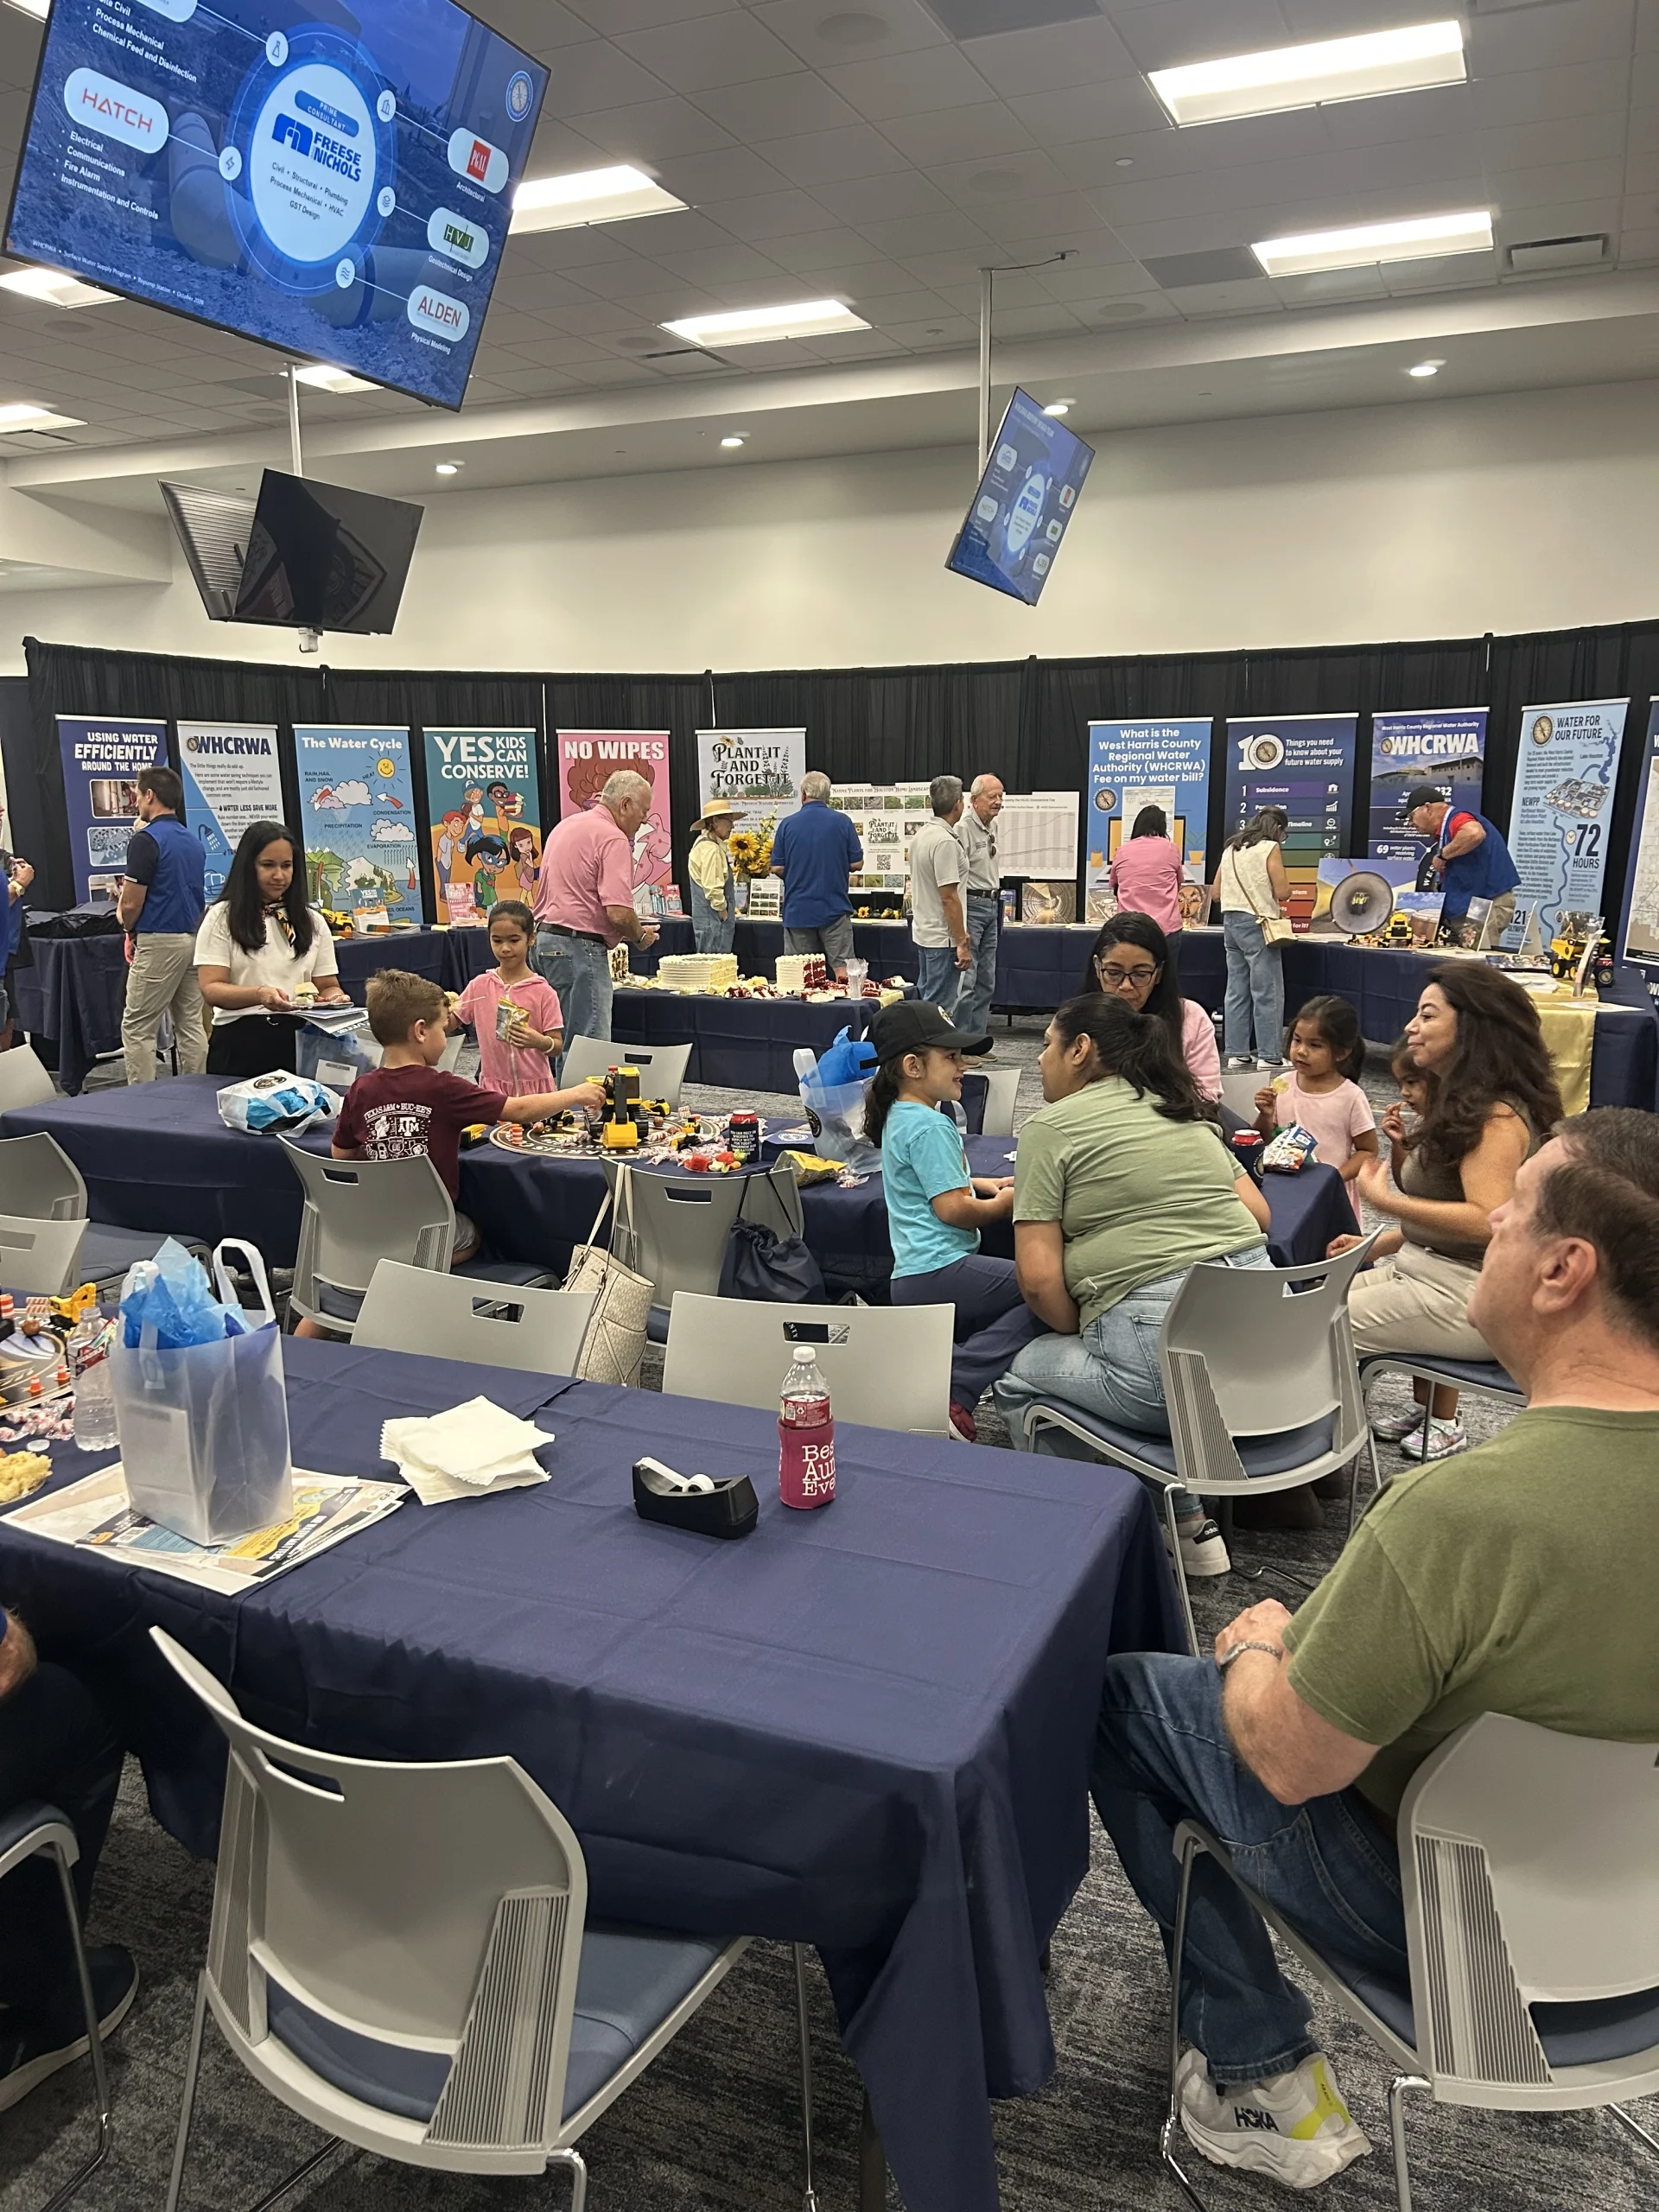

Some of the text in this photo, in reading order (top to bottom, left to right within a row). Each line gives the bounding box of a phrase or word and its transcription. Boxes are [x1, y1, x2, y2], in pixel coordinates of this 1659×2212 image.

[114, 0, 131, 16] Civil
[95, 8, 164, 50] Process Mechanical
[92, 23, 197, 83] Chemical Feed and Disinfection
[82, 88, 153, 133] HATCH
[320, 101, 338, 117] PRIME
[307, 105, 346, 131] CONSULTANT
[70, 130, 104, 152] Electrical
[314, 131, 362, 167] FREESE
[67, 146, 125, 177] Communications
[313, 147, 362, 182] NICHOLS
[470, 149, 486, 173] PGAL
[64, 160, 100, 181] Fire Alarm
[271, 162, 349, 207] Civil Structural Plumbing
[456, 181, 486, 203] Architectural
[61, 174, 159, 220] Instrumentation and Controls
[270, 175, 345, 217] Process Mechanical HVAC
[289, 200, 321, 220] GST Design
[444, 225, 472, 251] HVJ
[428, 255, 458, 276] Geotechnical
[457, 268, 474, 283] Design
[417, 296, 462, 327] ALDEN
[411, 332, 451, 355] Physical Modeling
[1556, 715, 1601, 728] WATER FOR
[87, 732, 158, 744] USING WATER
[1120, 728, 1180, 739] What is the
[1554, 728, 1603, 741] OUR FUTURE
[193, 736, 272, 755] WHCRWA
[302, 737, 403, 752] The Water Cycle
[434, 735, 495, 763] YES
[495, 736, 526, 749] KIDS
[564, 741, 664, 760] NO WIPES
[1098, 739, 1202, 750] West Harris County
[1285, 738, 1306, 748] Things
[1306, 739, 1318, 748] you
[1389, 733, 1478, 756] WHCRWA
[74, 743, 158, 760] EFFICIENTLY
[496, 749, 527, 762] CAN
[712, 743, 781, 763] PLANT IT
[1109, 751, 1191, 763] Regional Water
[1328, 748, 1344, 758] your
[81, 760, 153, 772] AROUND THE HOME
[729, 760, 760, 772] AND
[1092, 760, 1206, 774] Authority (WHCRWA)
[1323, 757, 1344, 767] supply
[361, 771, 376, 780] HEAT
[441, 764, 530, 779] CONSERVE!
[710, 770, 790, 788] FORGET IT
[1094, 774, 1112, 784] Fee
[1128, 775, 1147, 785] my
[1148, 773, 1180, 782] water
[1181, 772, 1205, 782] bill?
[1242, 785, 1247, 797] 1
[1239, 802, 1247, 814] 2
[1522, 797, 1541, 807] NEWPP
[868, 820, 888, 829] PLANT
[1239, 819, 1246, 830] 3
[1574, 823, 1601, 857] 72
[1376, 844, 1389, 855] 69
[1573, 857, 1600, 869] HOURS
[1422, 864, 1435, 887] WES
[1510, 910, 1527, 925] 21
[363, 1106, 384, 1121] TEXAS
[802, 1440, 835, 1462] Bes
[802, 1460, 836, 1482] Aun
[802, 1478, 836, 1497] Eve
[1204, 1526, 1219, 1535] adida
[1234, 2106, 1280, 2133] HOKA
